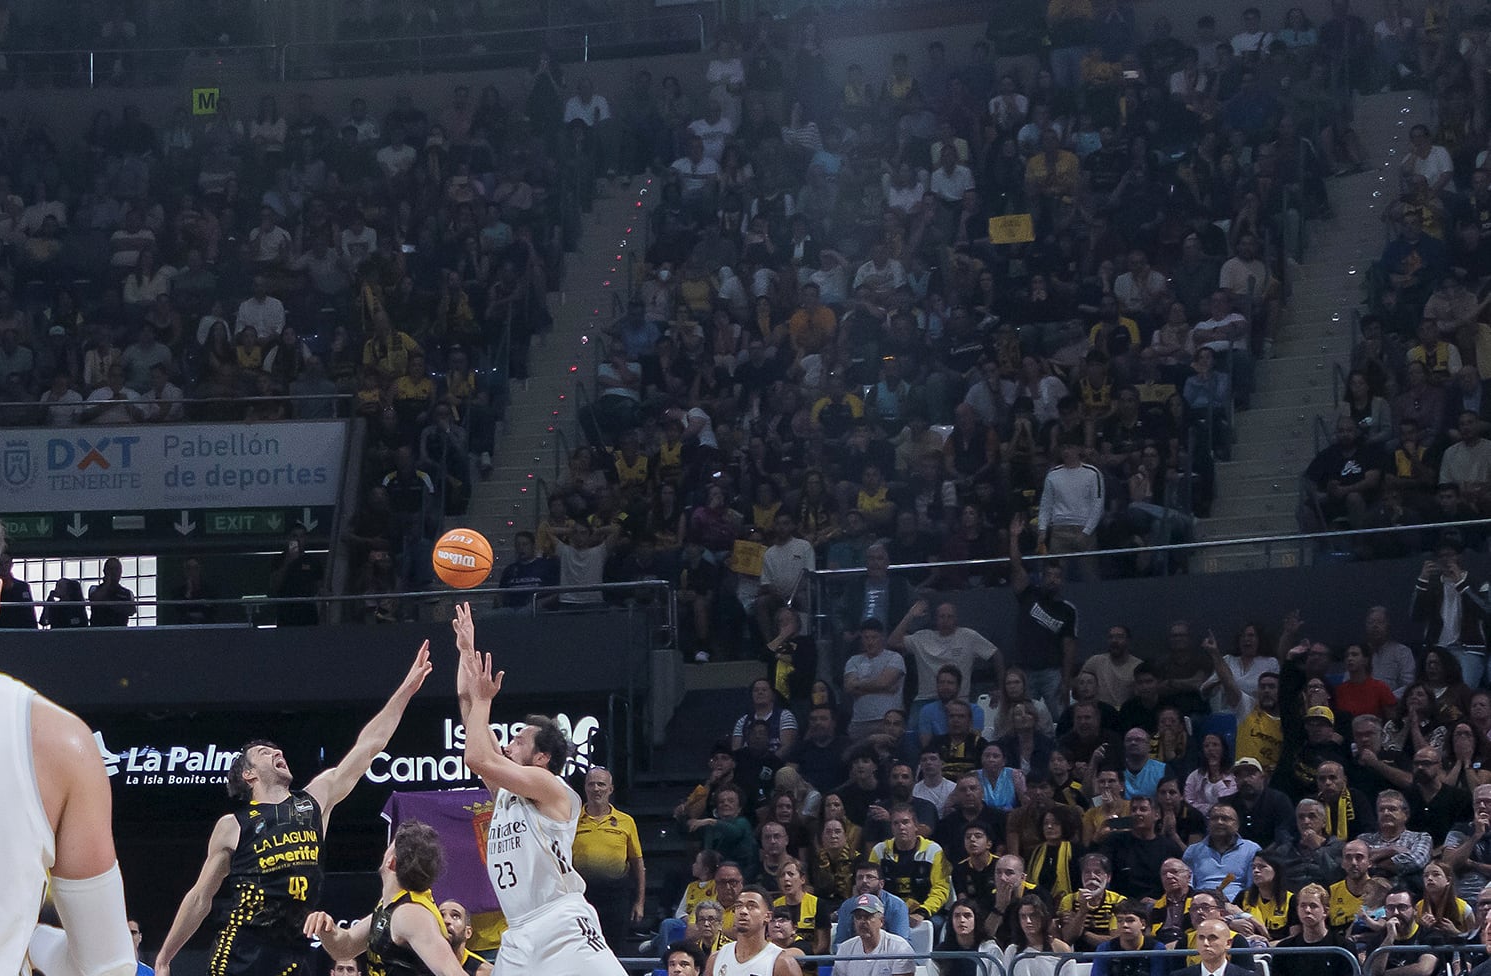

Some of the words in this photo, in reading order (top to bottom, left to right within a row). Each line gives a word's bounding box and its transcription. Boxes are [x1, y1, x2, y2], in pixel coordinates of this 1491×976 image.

[198, 92, 215, 110] M
[47, 436, 140, 471] DXT
[164, 433, 279, 459] Pabellón
[47, 474, 141, 491] TENERIFE
[164, 464, 195, 488] de
[205, 461, 327, 490] deportes
[215, 515, 255, 531] EXIT
[126, 747, 162, 772] La
[167, 744, 242, 772] Palm
[126, 775, 139, 785] La
[143, 775, 163, 785] Isla
[168, 775, 206, 785] Bonita
[494, 861, 518, 890] 23
